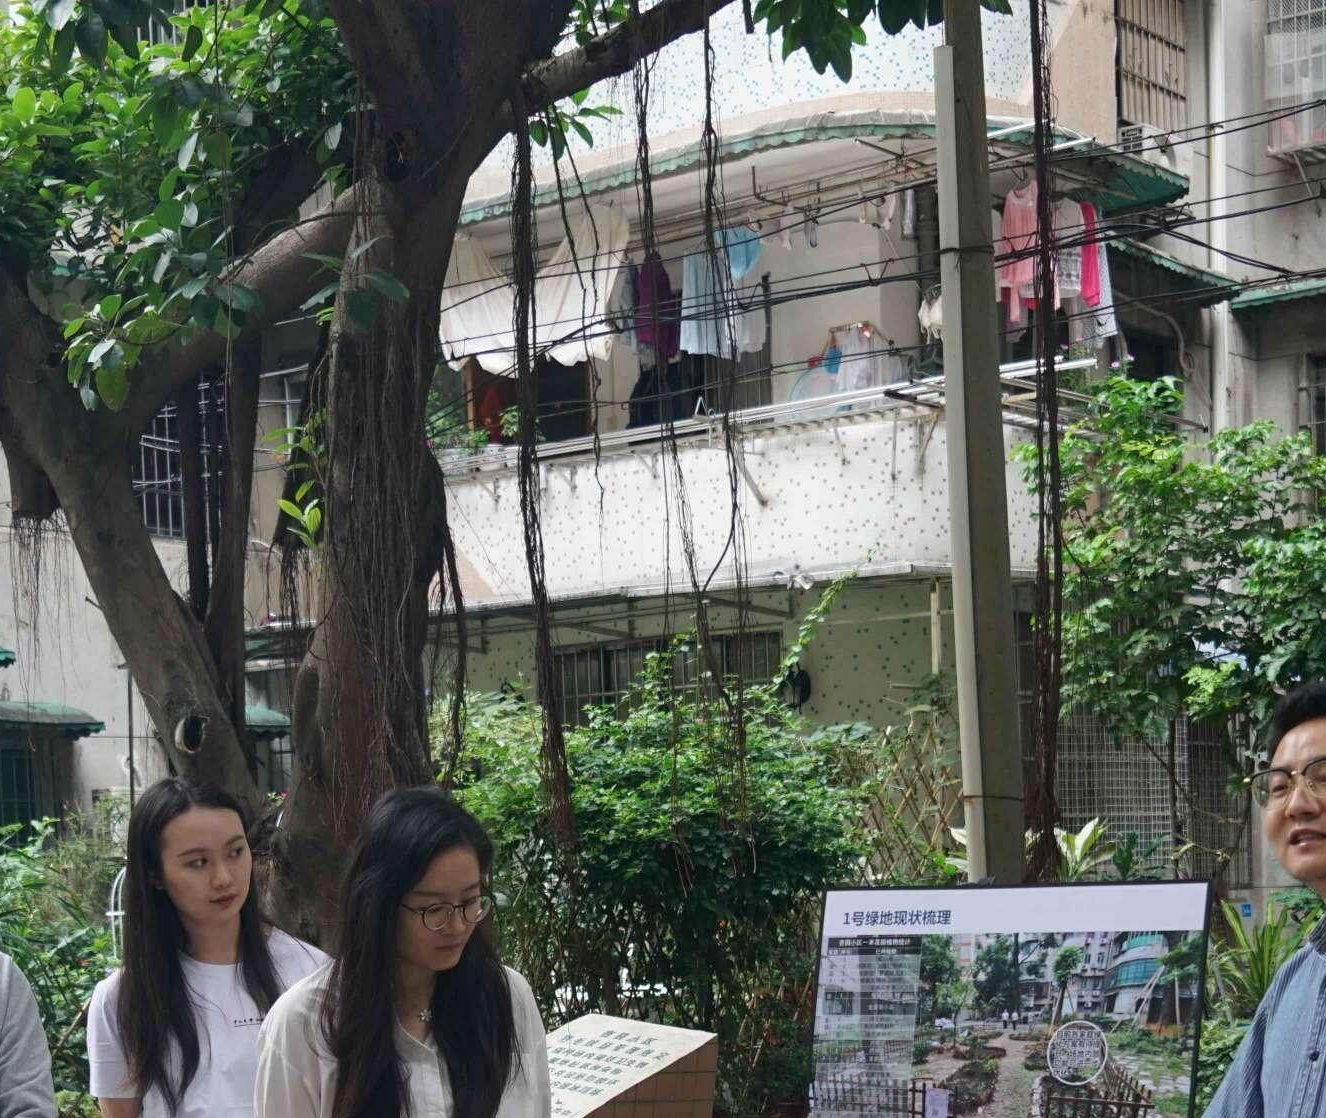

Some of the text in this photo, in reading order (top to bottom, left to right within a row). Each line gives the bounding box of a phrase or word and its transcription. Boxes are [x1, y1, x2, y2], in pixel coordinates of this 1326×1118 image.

[842, 909, 952, 926] 1号绿地现状梳理
